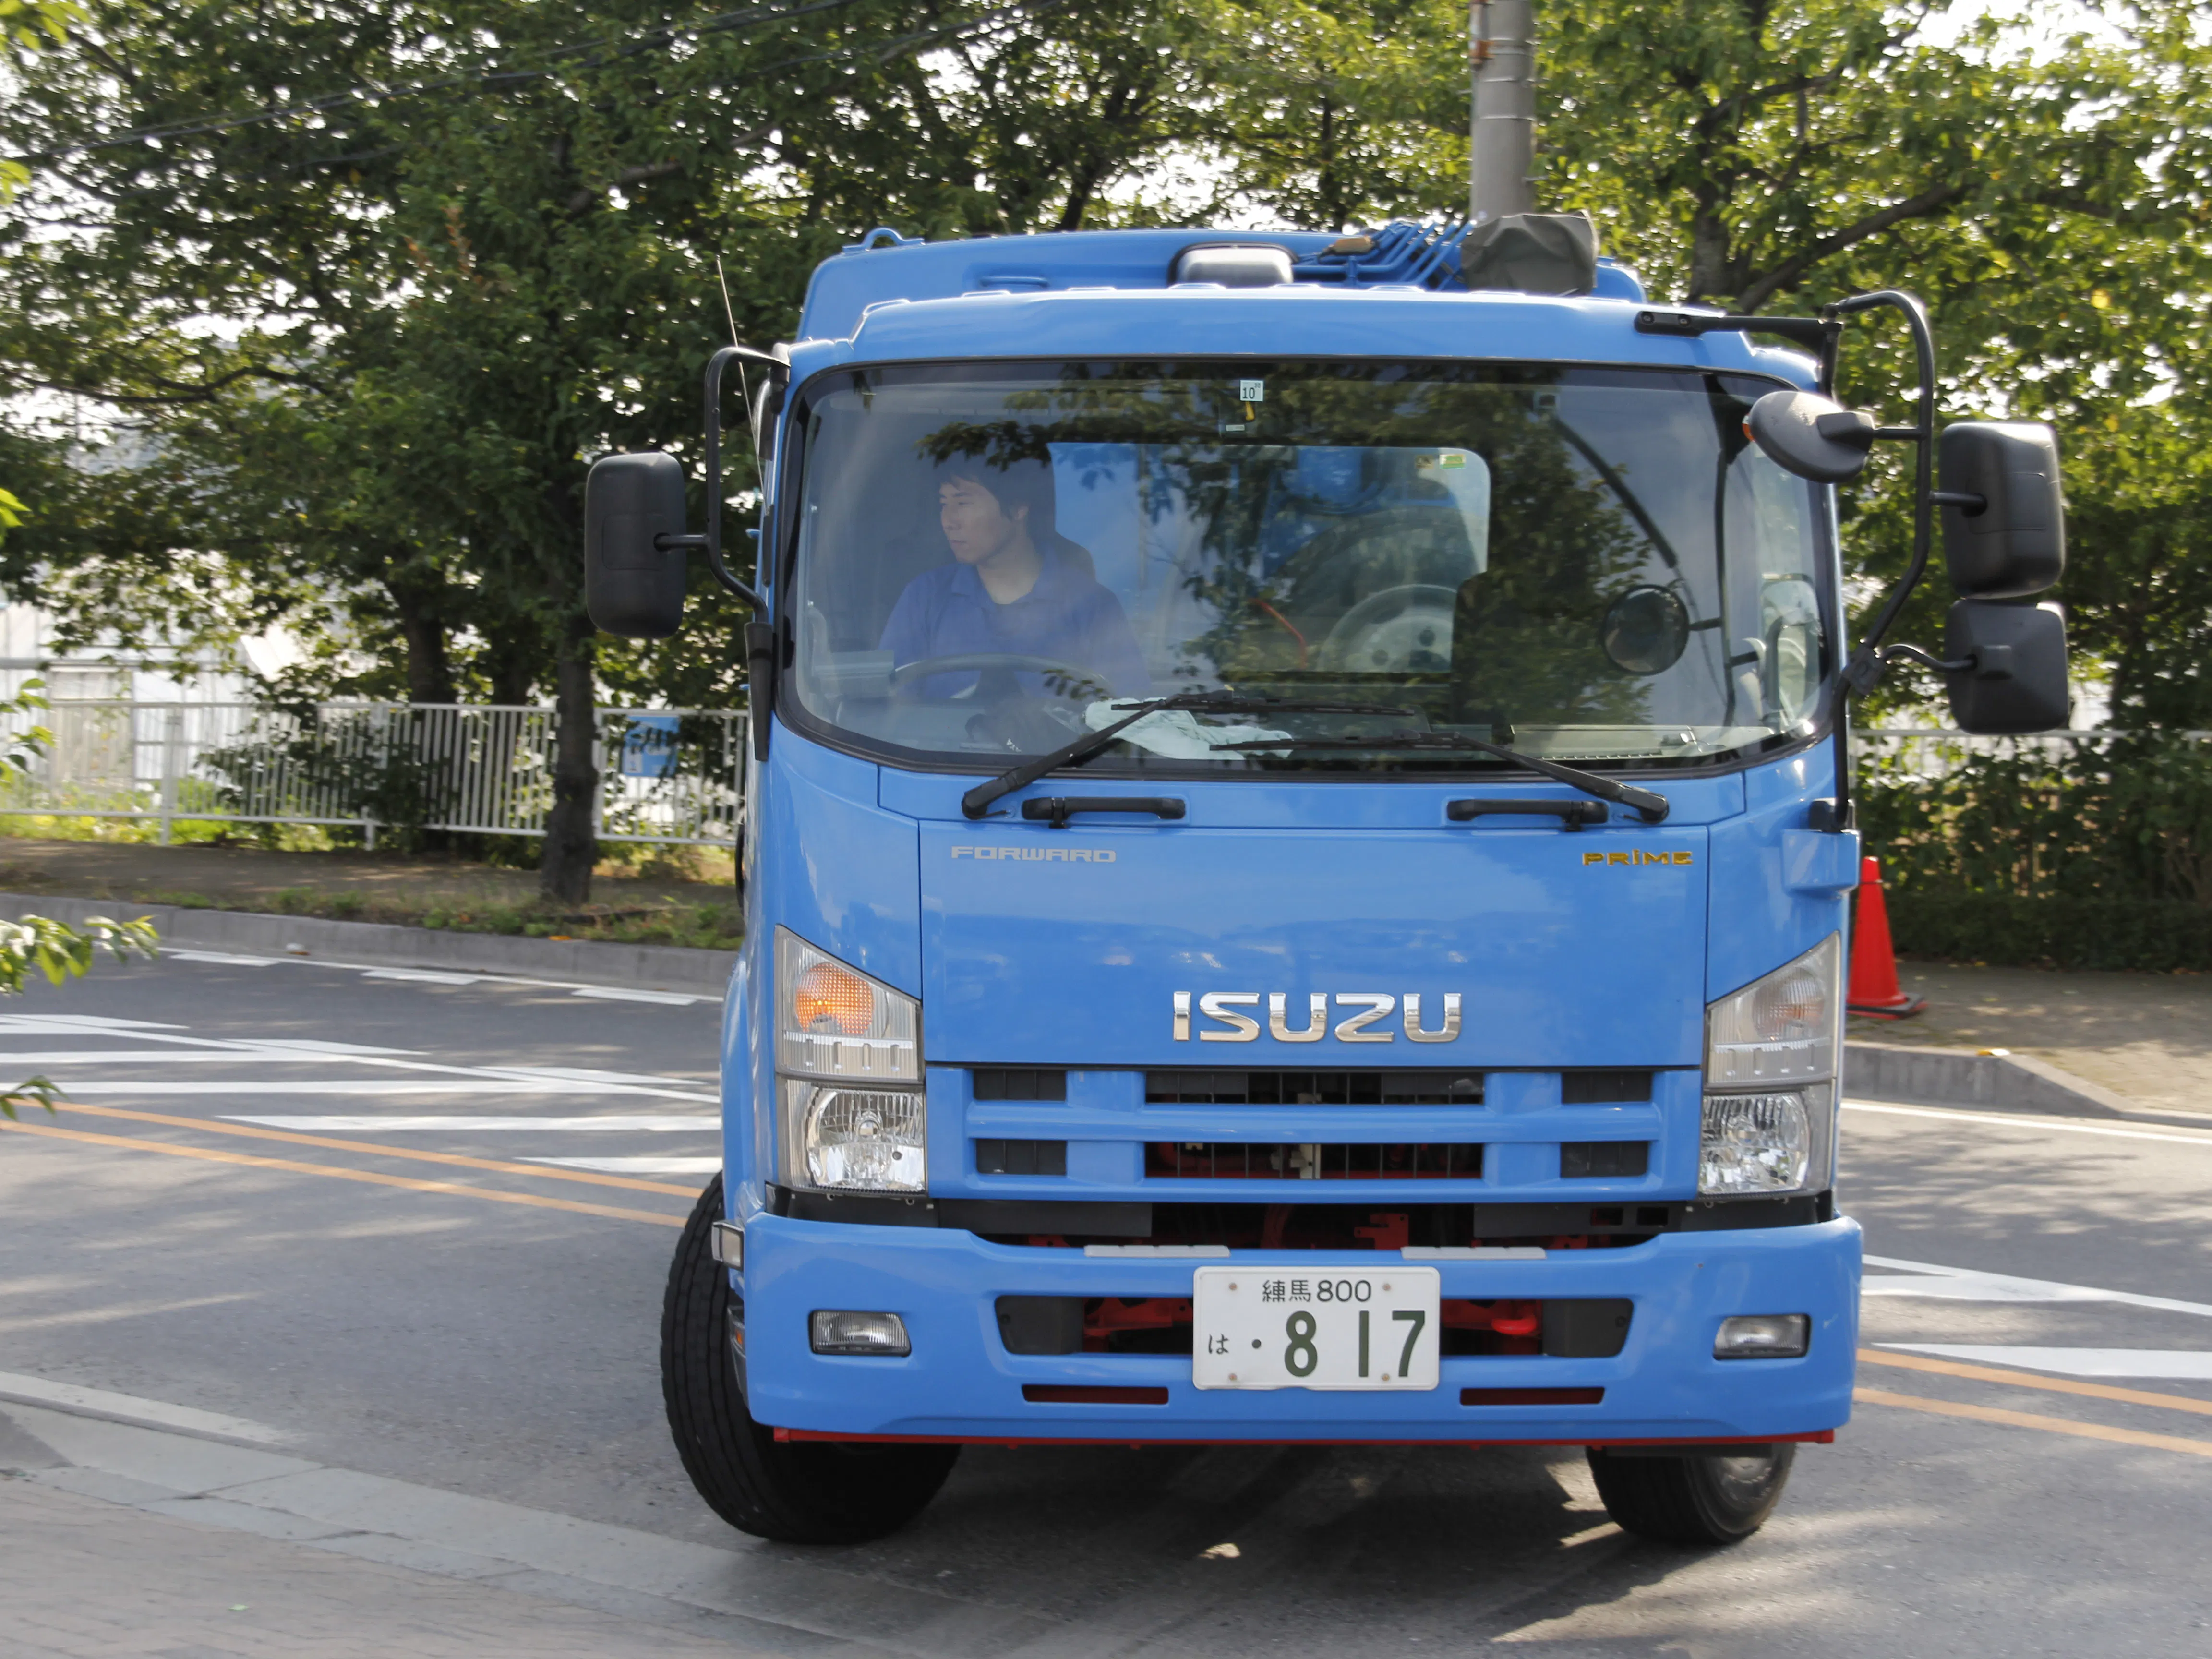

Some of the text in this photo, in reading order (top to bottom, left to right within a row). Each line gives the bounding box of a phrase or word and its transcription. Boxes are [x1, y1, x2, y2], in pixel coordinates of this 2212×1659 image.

[1242, 387, 1255, 399] 10
[951, 845, 1117, 863] FORWARD
[1173, 991, 1461, 1042] ISUZU
[1208, 1333, 1229, 1354] は
